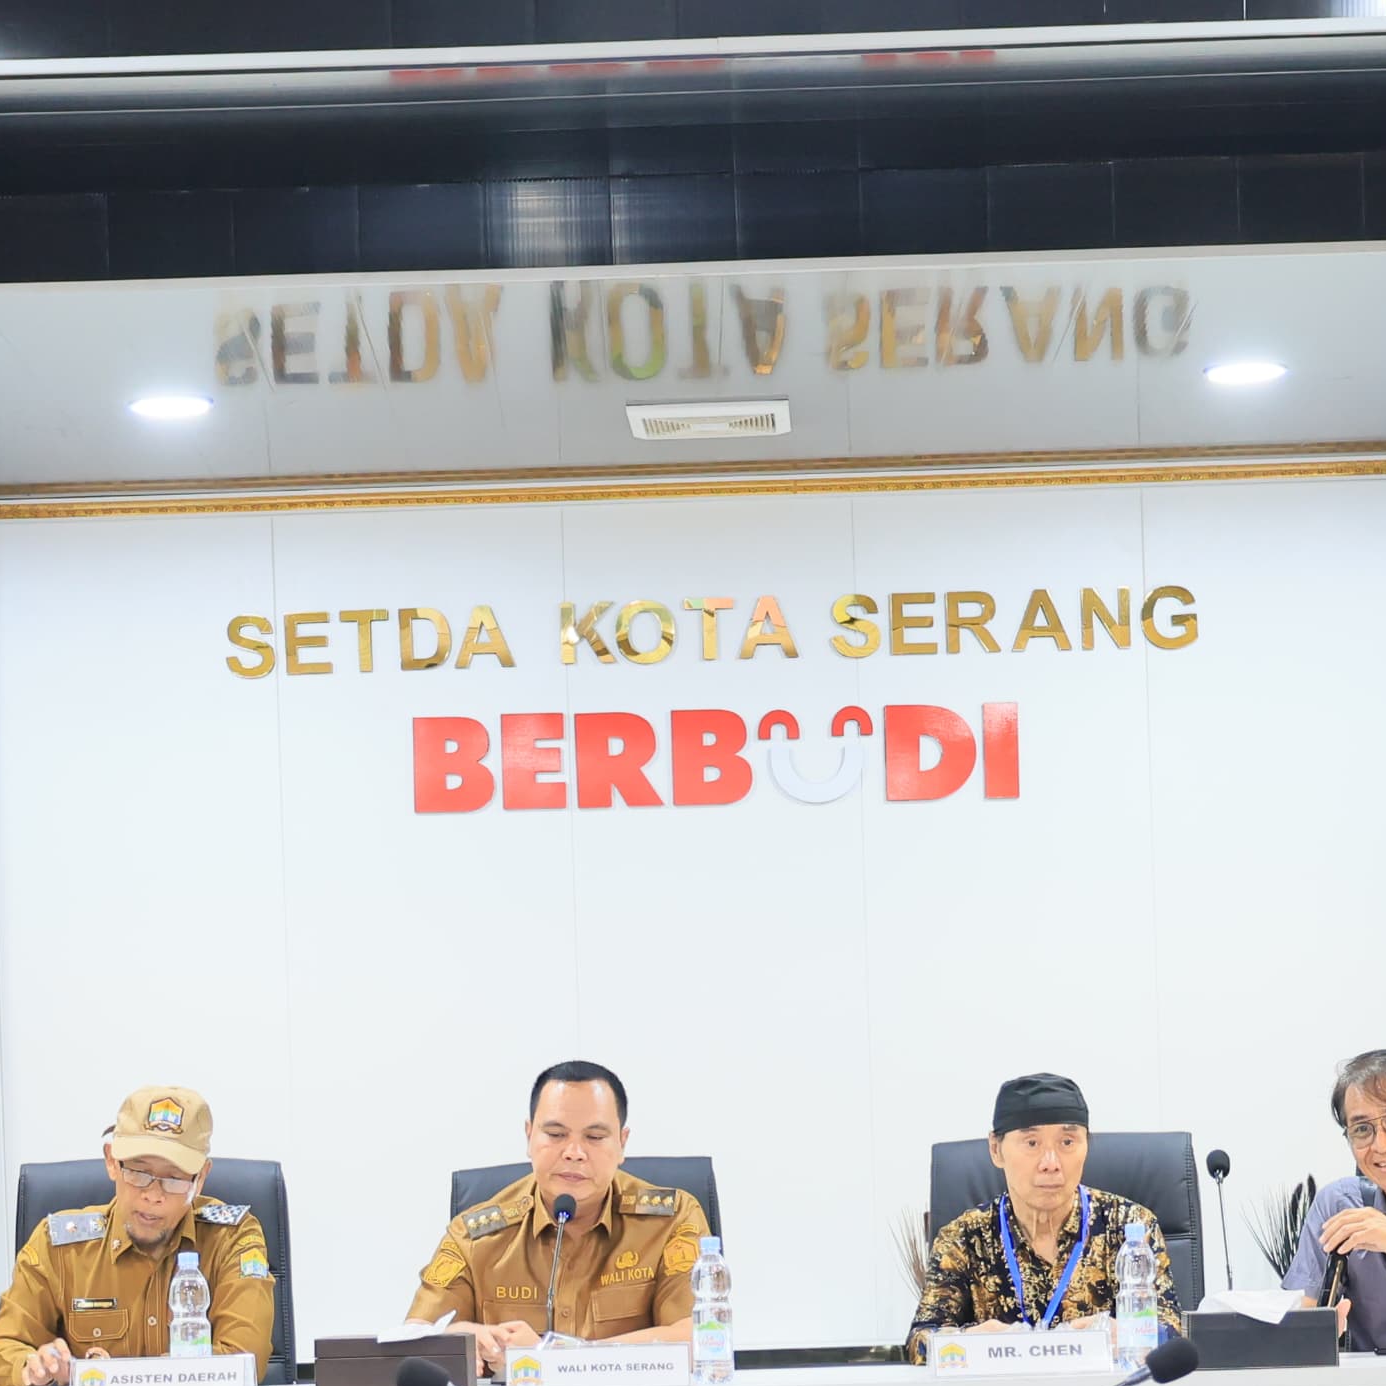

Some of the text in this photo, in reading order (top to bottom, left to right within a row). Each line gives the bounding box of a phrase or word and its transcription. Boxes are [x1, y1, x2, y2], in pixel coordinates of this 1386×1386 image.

[225, 585, 1199, 680] SETDA KOTA SERANG
[412, 702, 1020, 814] BERBUDI
[601, 1267, 655, 1286] WALI KOTA
[496, 1286, 538, 1300] BUDI
[988, 1344, 1083, 1359] MR. CHEN
[557, 1362, 675, 1374] WALI KOTA SERANG
[110, 1371, 237, 1385] ASISTEN DAERAH
